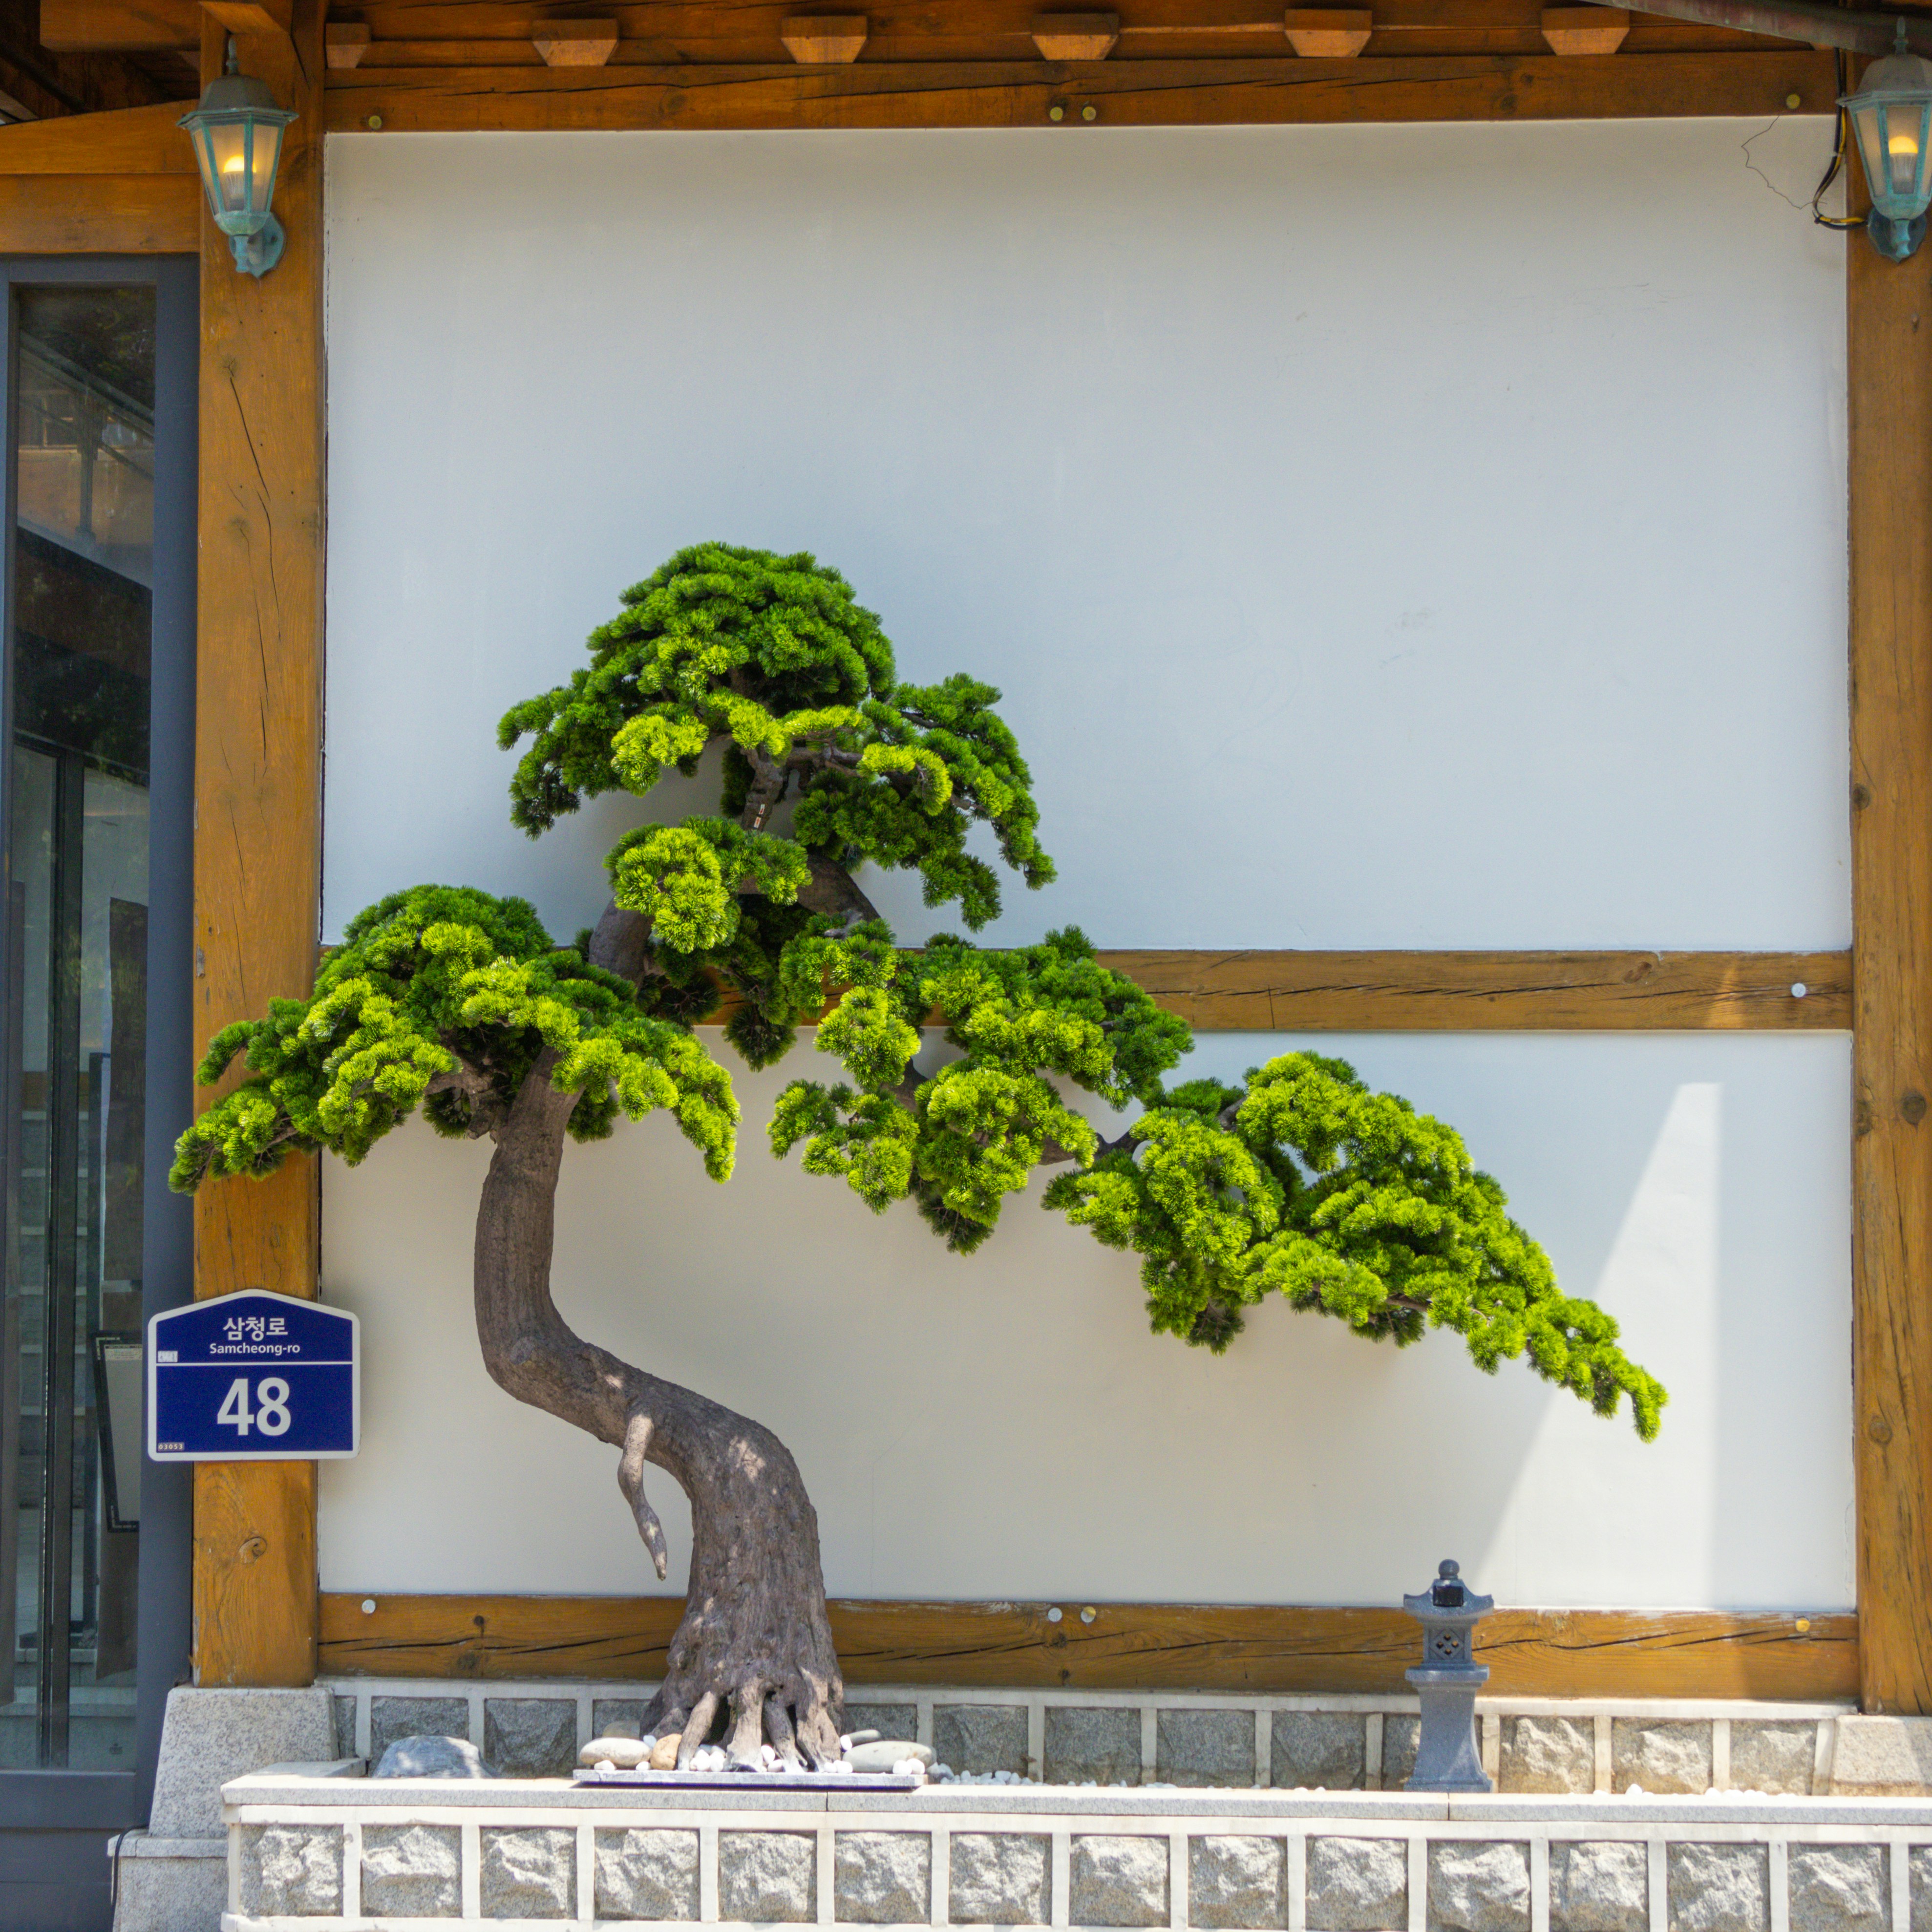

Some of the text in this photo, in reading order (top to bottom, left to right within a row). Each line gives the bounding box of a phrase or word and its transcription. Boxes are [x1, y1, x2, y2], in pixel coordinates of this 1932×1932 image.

[223, 1317, 288, 1341] 삼청로
[210, 1342, 300, 1356] Samcheong-ro
[217, 1377, 292, 1437] 48
